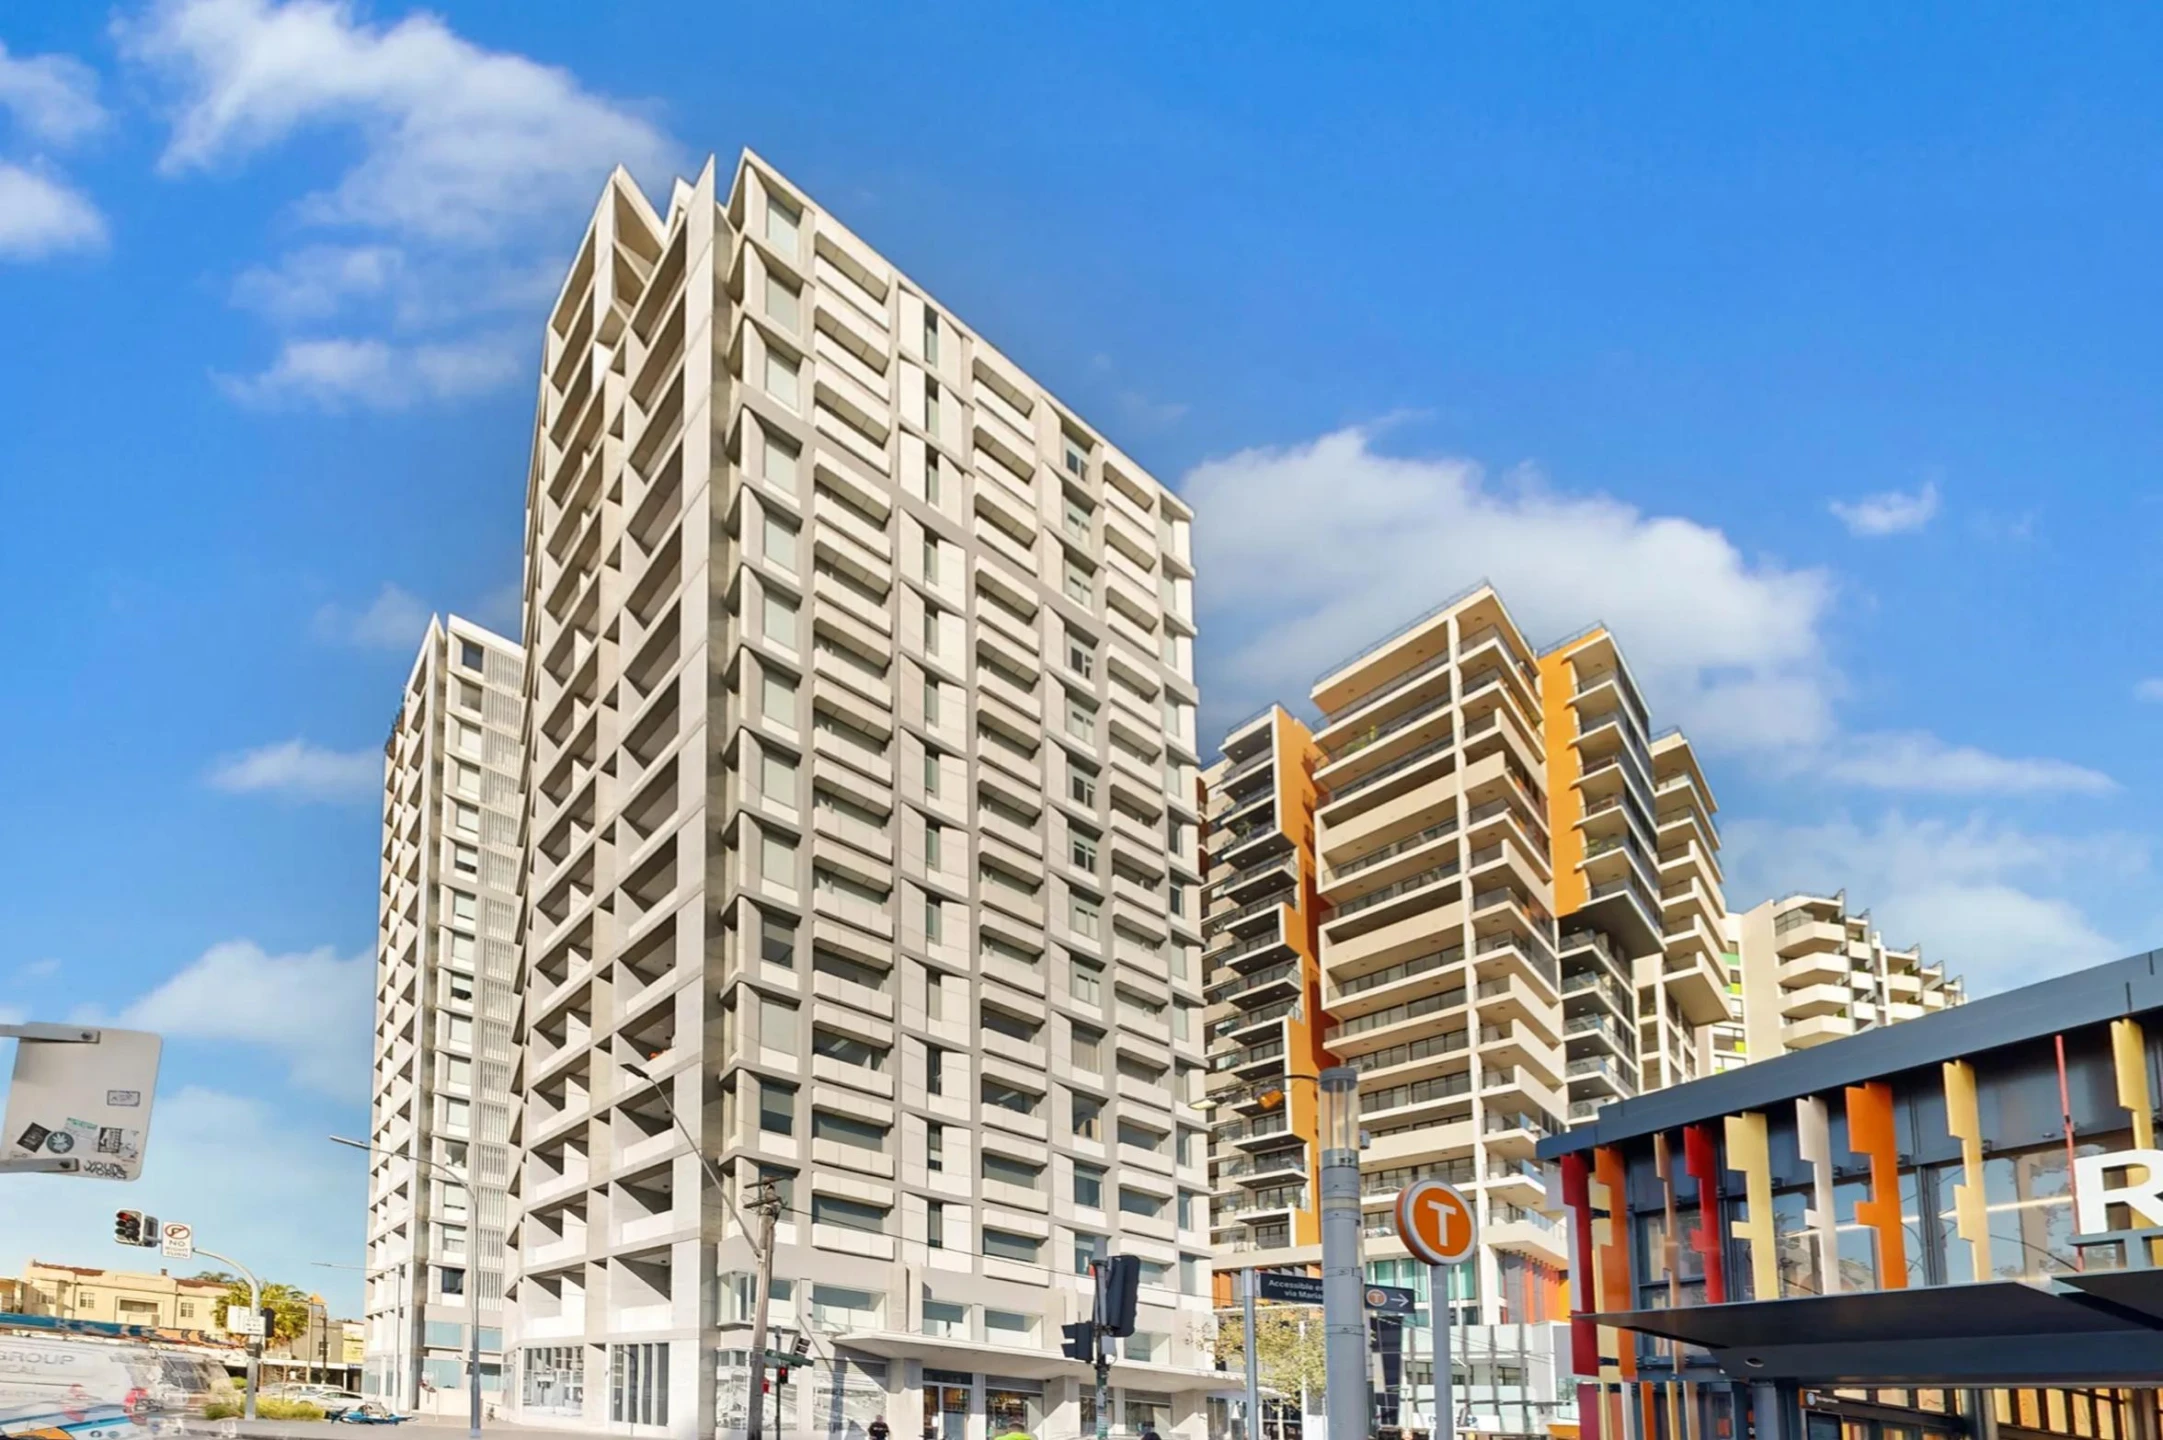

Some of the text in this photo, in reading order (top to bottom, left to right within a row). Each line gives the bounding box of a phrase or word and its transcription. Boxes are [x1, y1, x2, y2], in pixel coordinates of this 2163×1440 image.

[1427, 1200, 1457, 1246] T
[1268, 1279, 1313, 1291] Accessible
[1298, 1291, 1323, 1300] Maria
